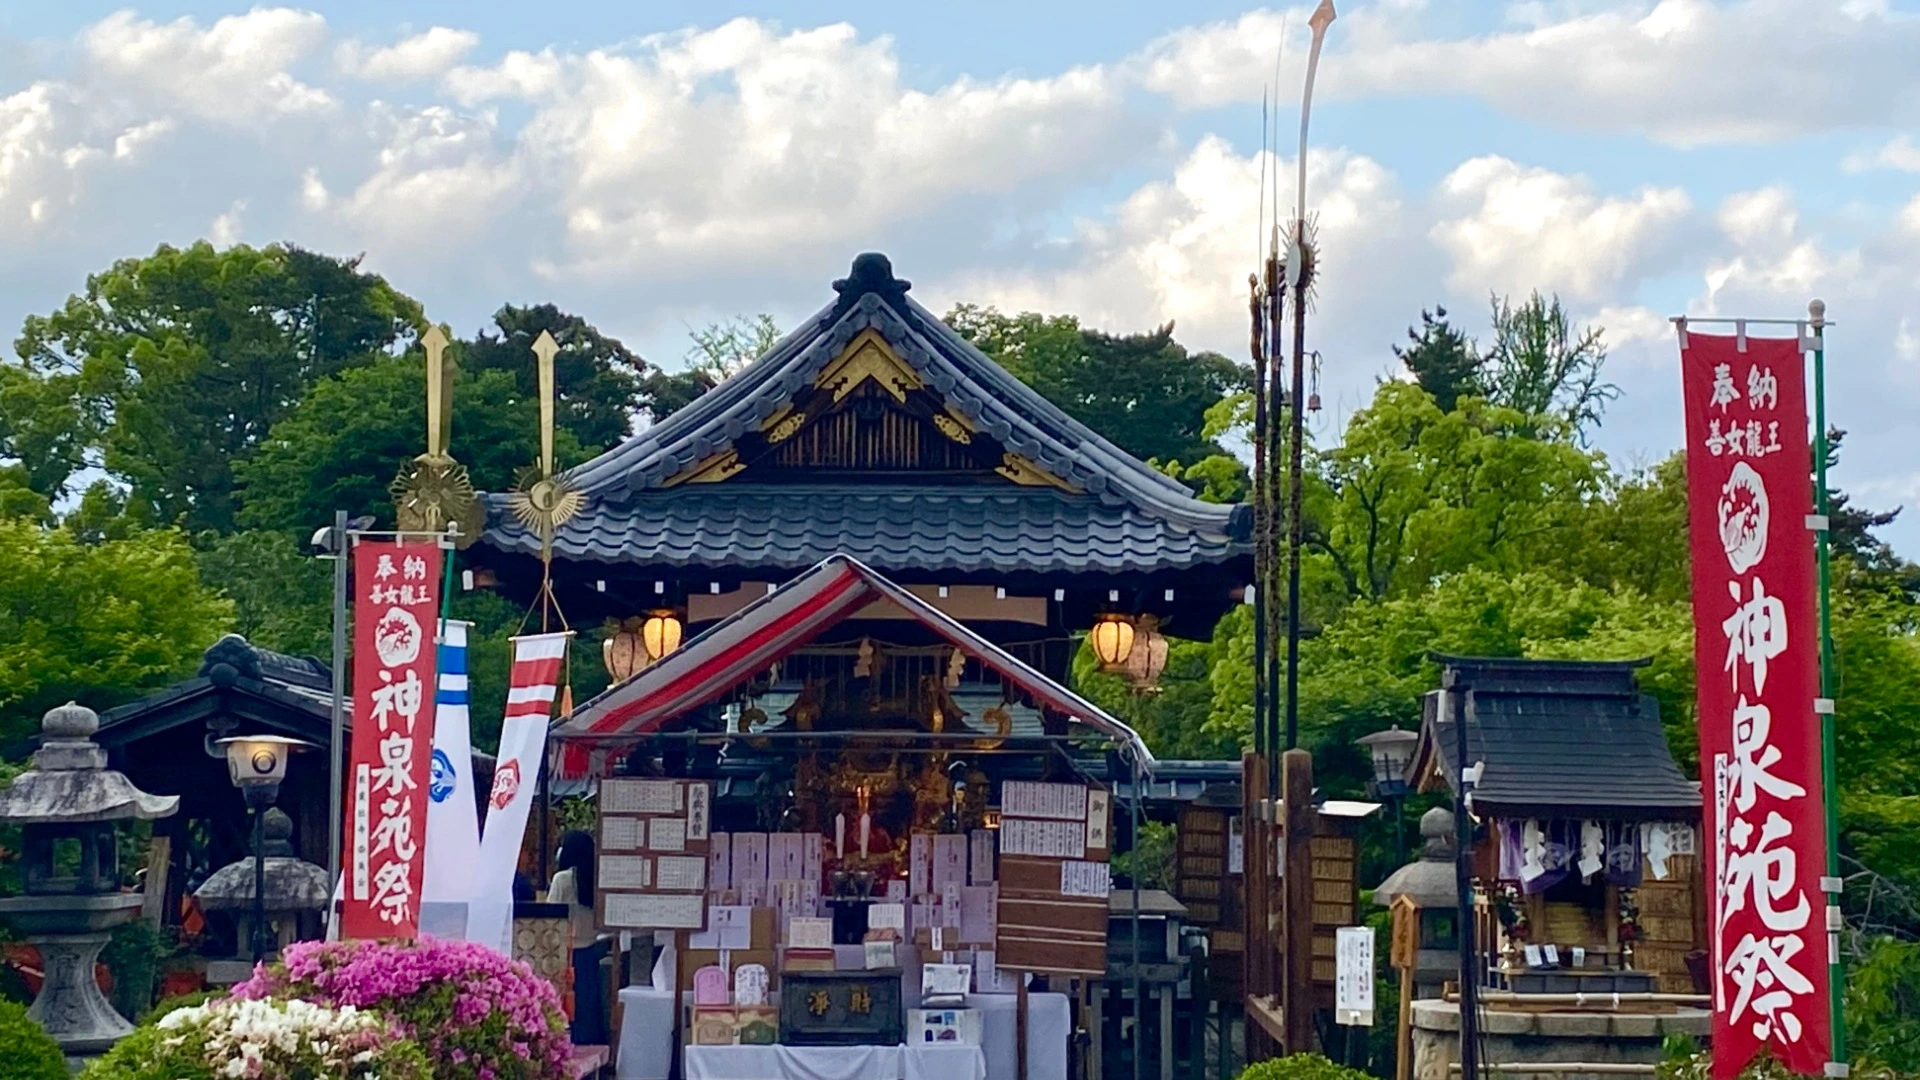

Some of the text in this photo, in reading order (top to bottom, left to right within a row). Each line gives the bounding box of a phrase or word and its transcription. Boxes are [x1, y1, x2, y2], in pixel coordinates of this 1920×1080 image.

[1710, 363, 1777, 414] 奉納
[1705, 419, 1782, 457] 善女龍王
[374, 554, 426, 581] 奉納
[368, 584, 432, 606] 善女龍王
[369, 669, 424, 926] 神泉苑祭
[1722, 576, 1815, 1045] 神泉苑祭
